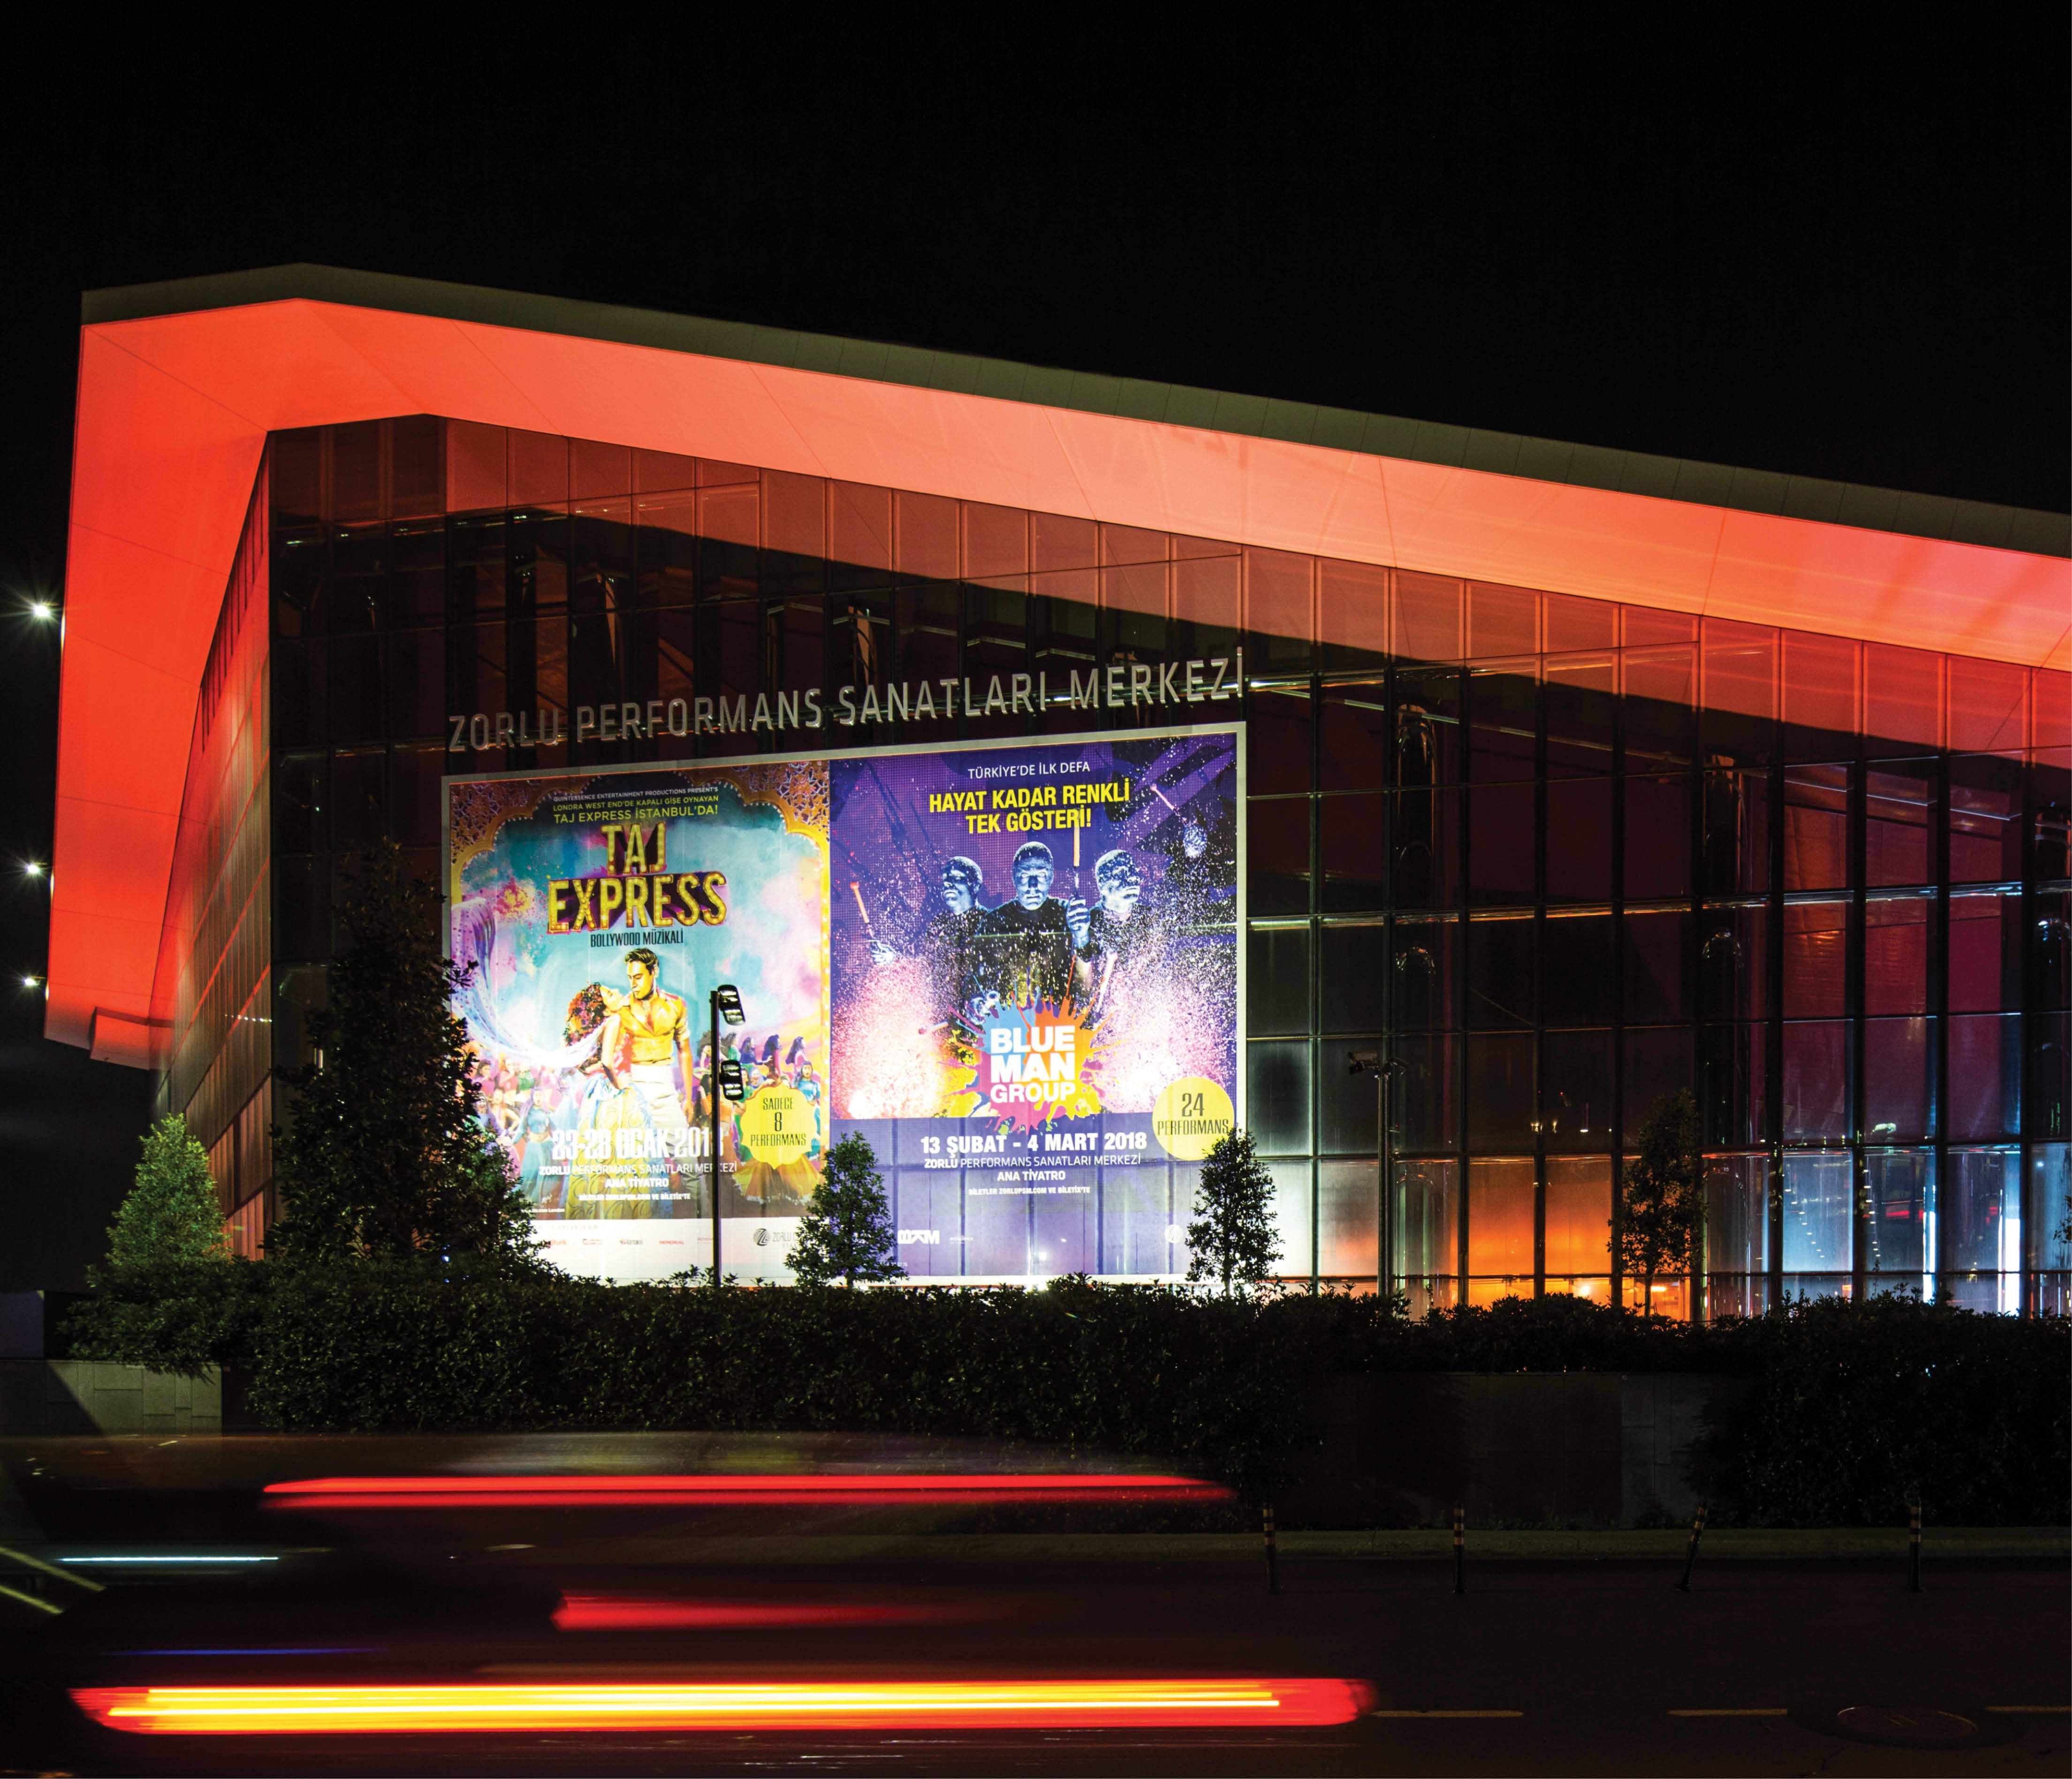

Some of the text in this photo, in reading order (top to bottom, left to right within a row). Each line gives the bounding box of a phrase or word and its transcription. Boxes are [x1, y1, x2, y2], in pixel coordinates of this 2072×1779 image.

[448, 646, 1243, 752] ZORLU PERFORMANS SANATLARI MERKEZİ
[1039, 762, 1057, 775] İLK
[1060, 761, 1090, 774] DEFA
[930, 777, 1130, 813] HAYAT KADAR RENKLİ
[554, 805, 718, 824] TAJ EXPRESS İSTANBUL'DA!
[965, 804, 1092, 834] TEK GÖSTERİ!
[600, 822, 667, 875] TAJ
[547, 871, 727, 934] EXPRESS
[591, 928, 683, 947] BOLLYWOOD MÜZİKALİ
[991, 1026, 1075, 1054] BLUE
[991, 1052, 1075, 1083] MAN
[990, 1082, 1076, 1103] GROUP
[763, 1097, 795, 1110] SADECE
[1182, 1093, 1205, 1117] 24
[774, 1111, 782, 1132] 8
[1157, 1119, 1229, 1135] PERFORMANS
[552, 1129, 611, 1160] 23-28
[616, 1127, 670, 1159] OCAK
[751, 1133, 806, 1146] PERFORMANS
[921, 1136, 940, 1154] 13
[947, 1135, 1007, 1158] ŞUBAT
[1027, 1134, 1039, 1151] 4
[1045, 1133, 1098, 1151] MART
[1104, 1132, 1147, 1150] 2018
[539, 1162, 737, 1175] ZORLU PERFORMANS SANATLARI MEEZİ
[924, 1153, 1140, 1168] ZORLU PERFORMANS SANATLARI MERKEZİ
[605, 1176, 669, 1187] ANA TİYATRO
[997, 1169, 1066, 1181] ANA TİYATRO
